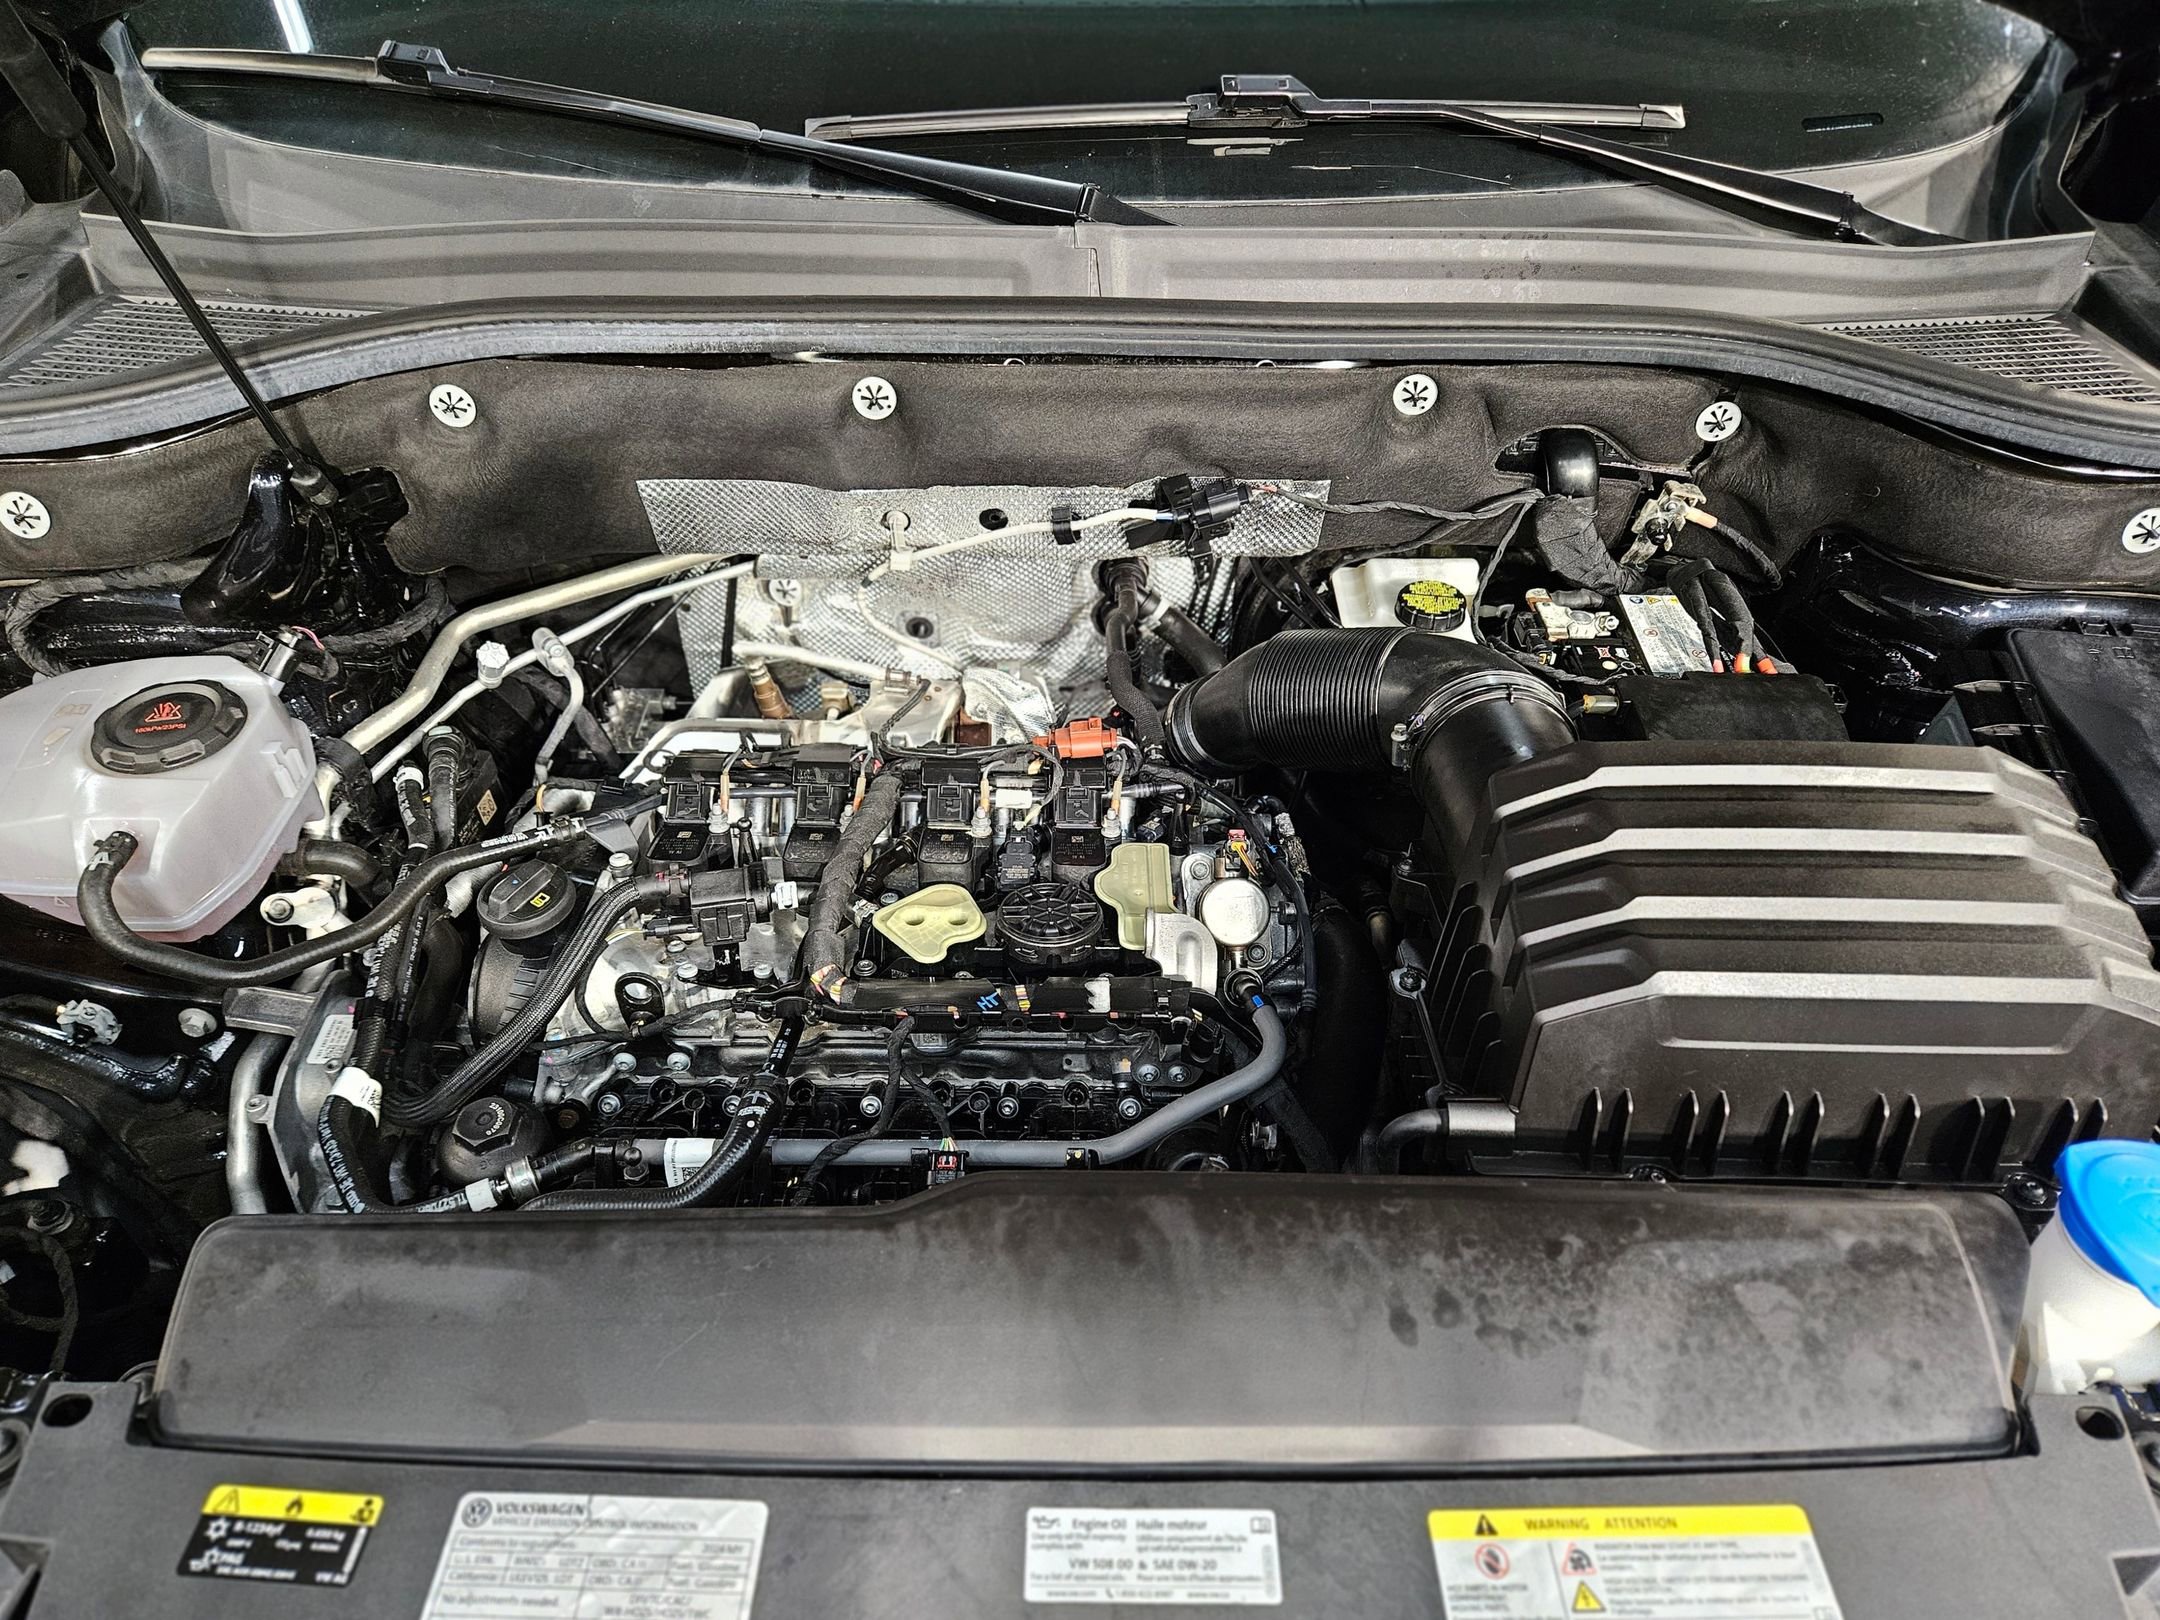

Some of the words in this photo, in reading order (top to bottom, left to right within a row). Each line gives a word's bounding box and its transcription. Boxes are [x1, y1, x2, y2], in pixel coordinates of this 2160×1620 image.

[1072, 1517, 1109, 1533] Engine
[1111, 1518, 1127, 1530] Oil
[1136, 1518, 1165, 1530] Huile
[1167, 1519, 1207, 1531] moteur
[1524, 1517, 1590, 1531] WARNING
[1604, 1516, 1679, 1530] ATTENTION
[1069, 1558, 1090, 1570] VW
[1152, 1558, 1175, 1571] SAE
